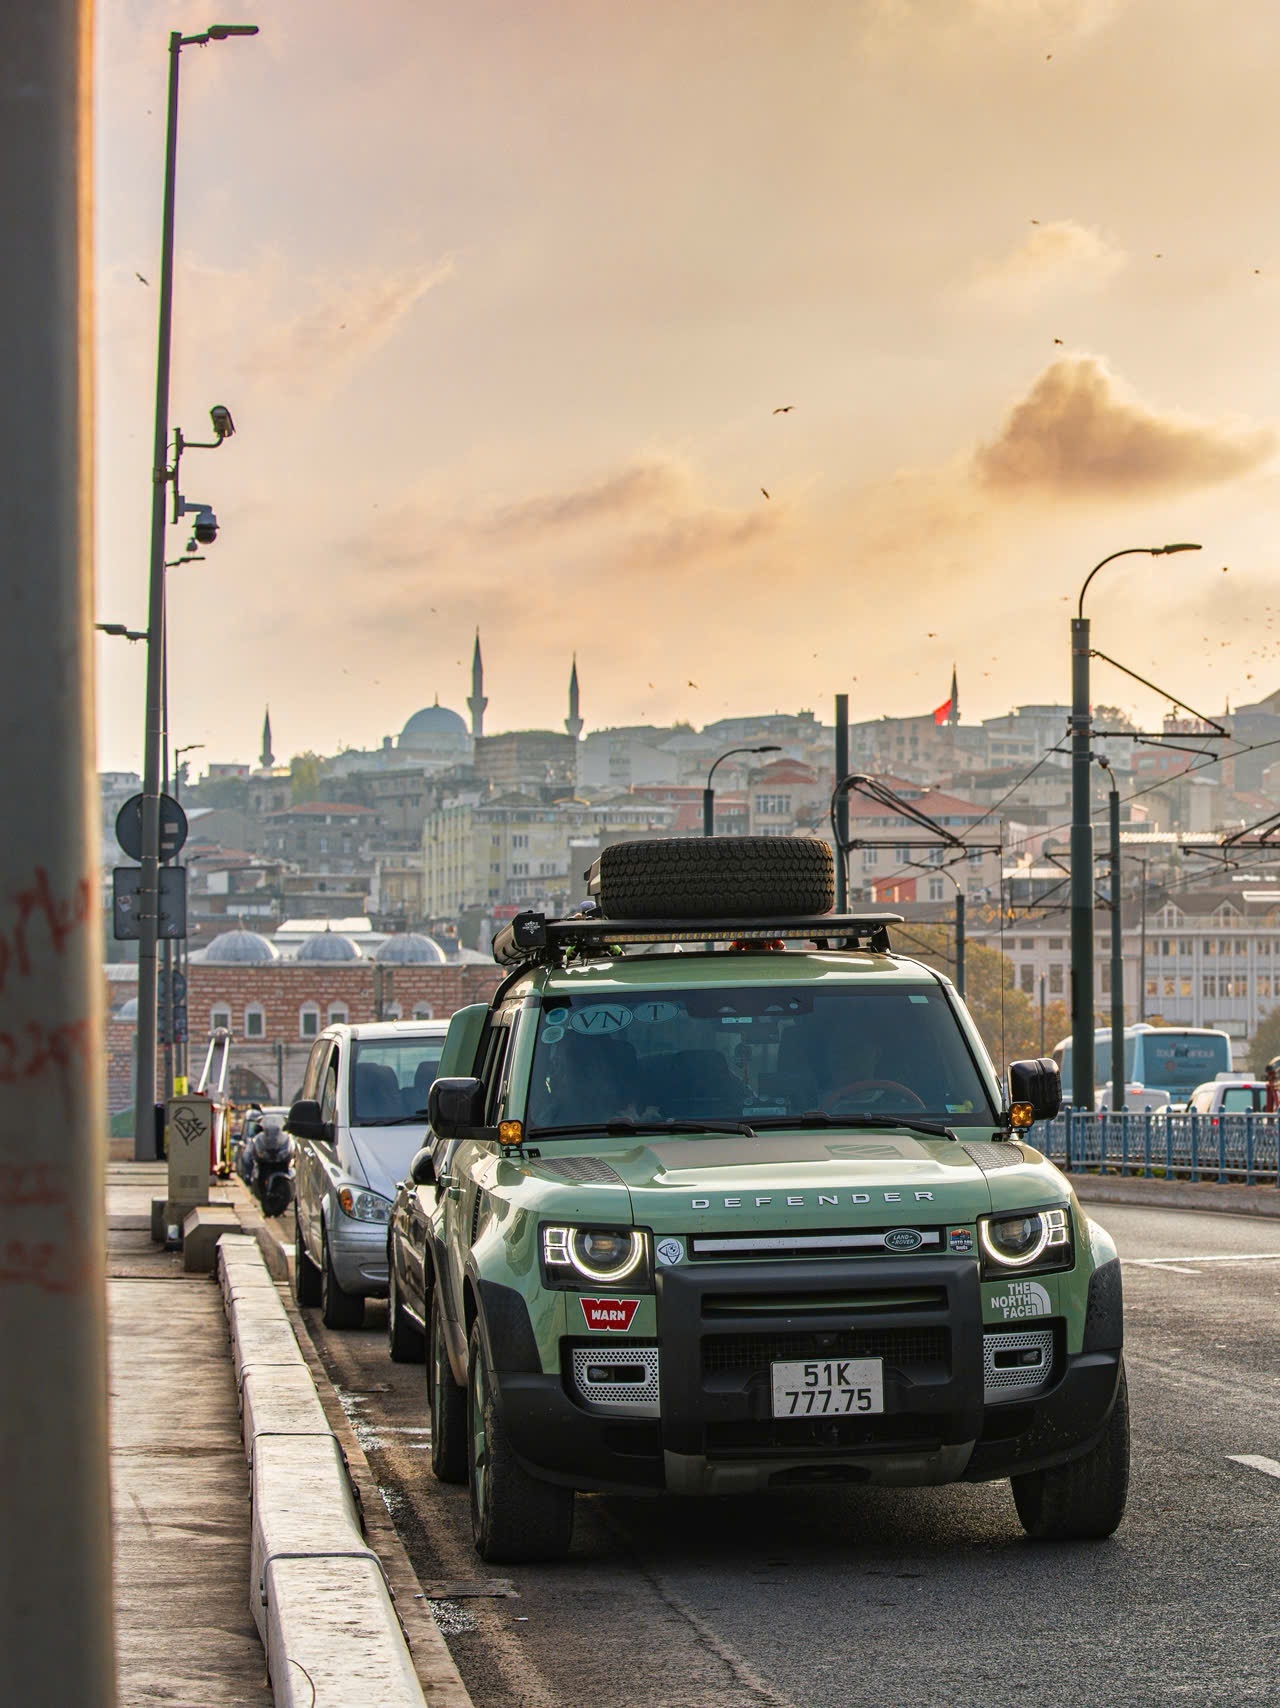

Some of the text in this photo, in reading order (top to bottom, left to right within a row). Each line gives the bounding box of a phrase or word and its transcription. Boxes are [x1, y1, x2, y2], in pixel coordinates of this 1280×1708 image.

[579, 1010, 624, 1029] VN
[648, 1004, 664, 1020] T
[691, 1191, 934, 1209] DEFENDER
[1008, 1282, 1030, 1295] THE
[991, 1294, 1031, 1308] NORTH
[591, 1309, 626, 1321] WARN
[1003, 1305, 1032, 1319] FACE
[804, 1363, 851, 1387] 51K
[785, 1388, 872, 1414] 777.75
